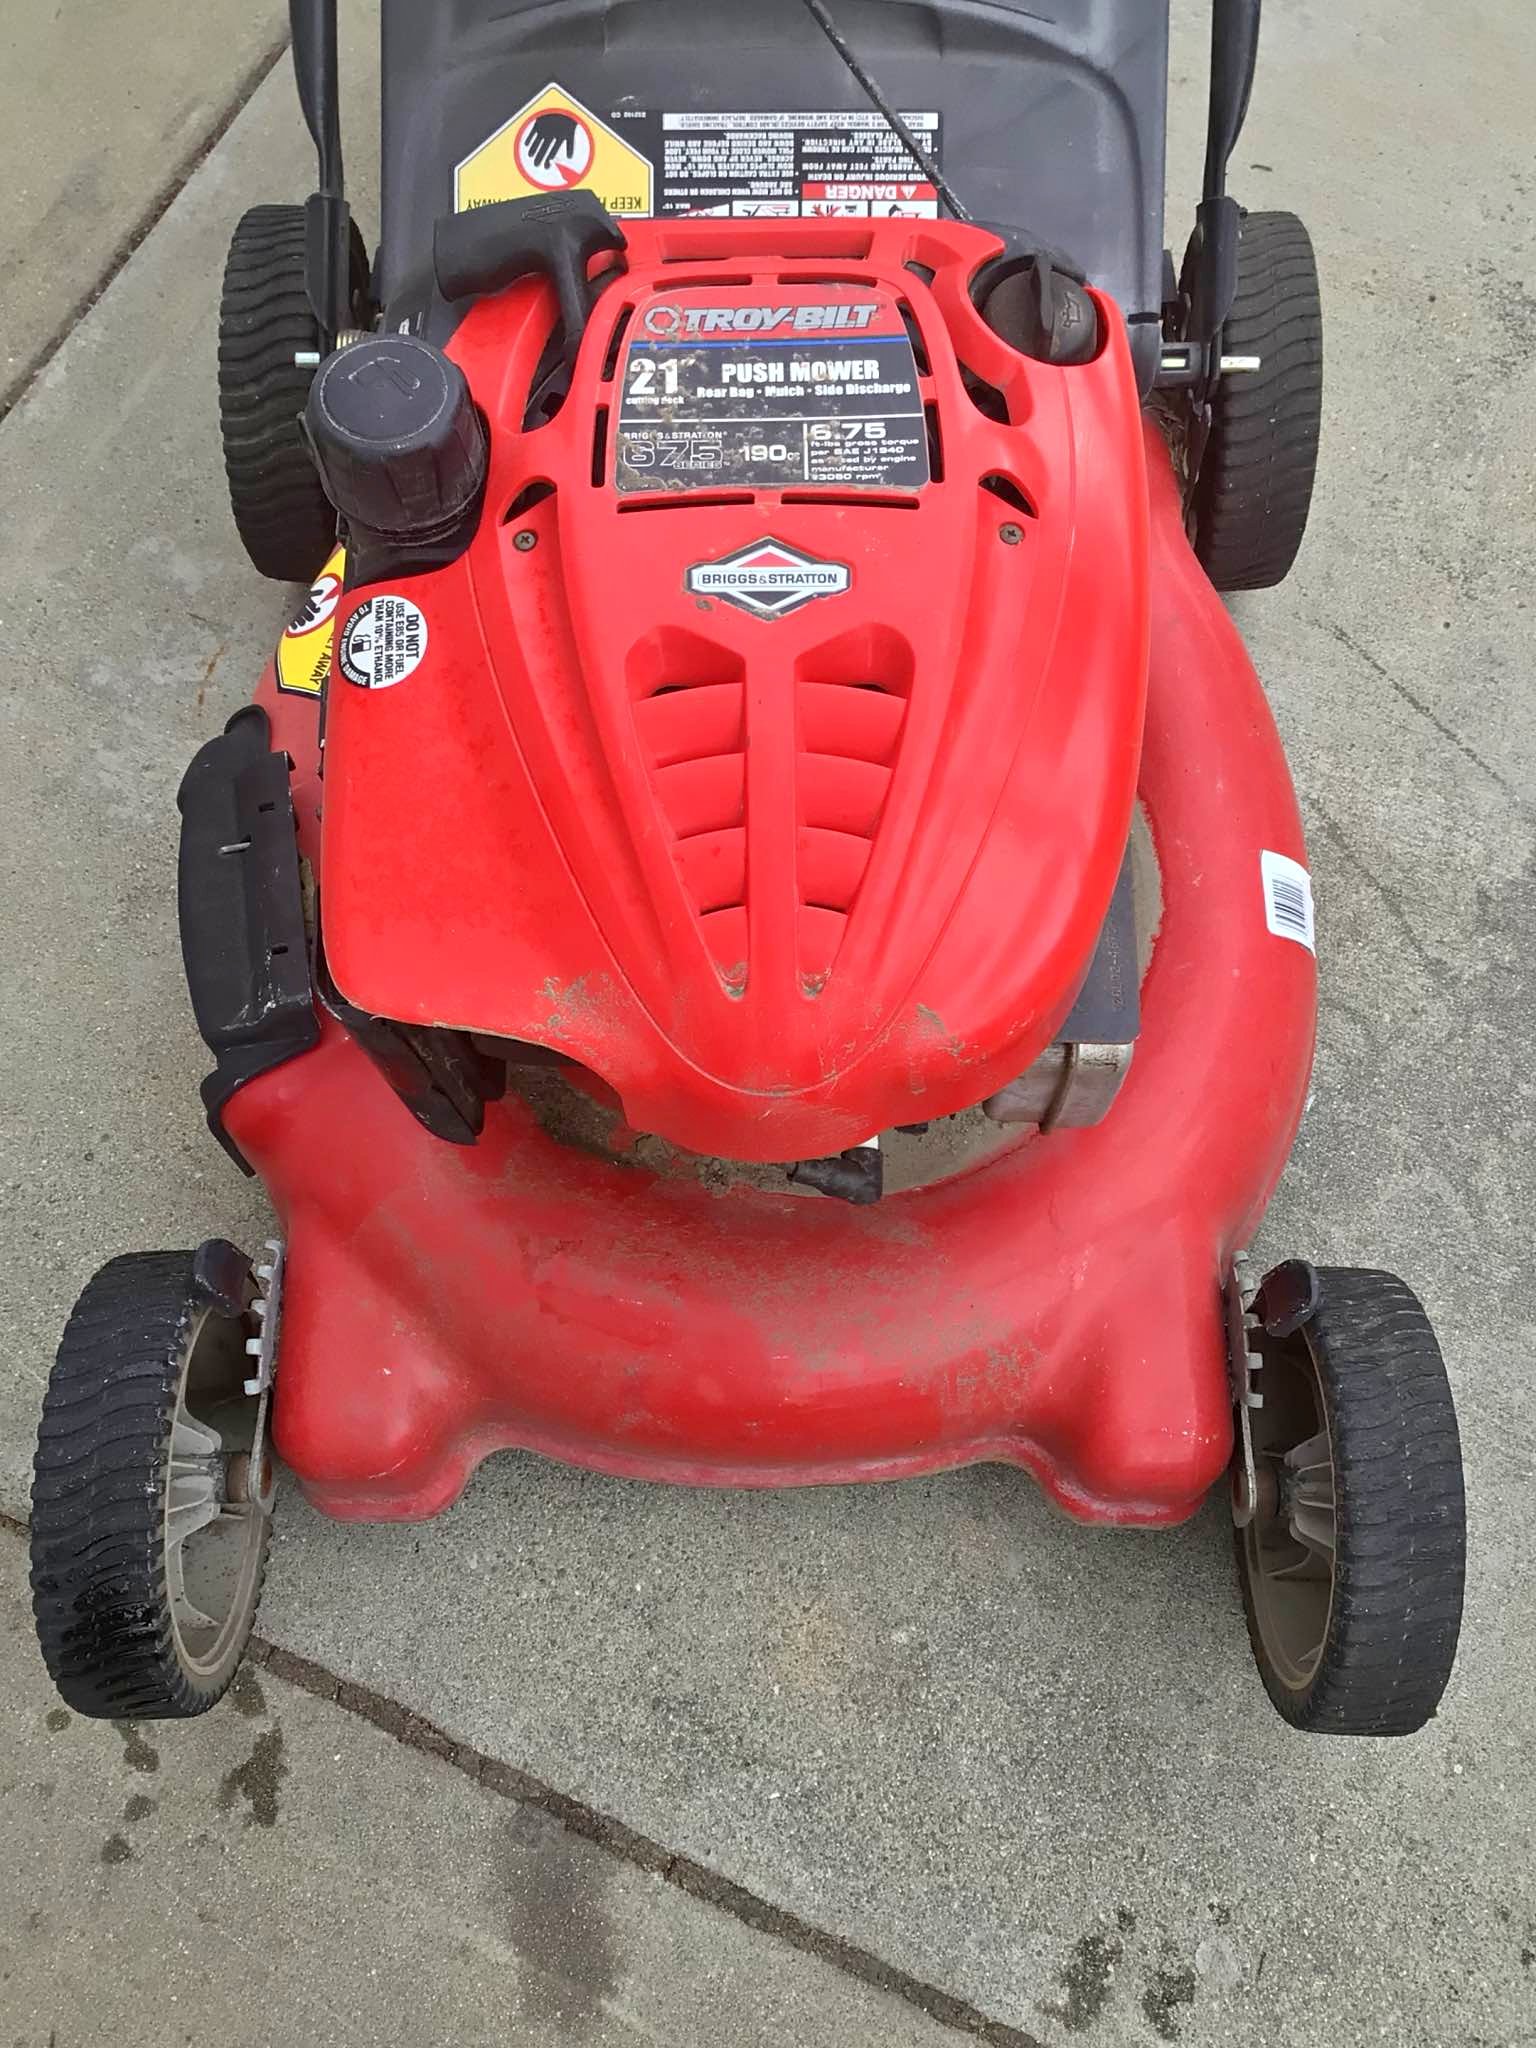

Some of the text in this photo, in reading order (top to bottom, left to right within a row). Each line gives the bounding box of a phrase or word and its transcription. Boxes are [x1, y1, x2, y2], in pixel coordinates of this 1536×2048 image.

[825, 185, 897, 199] DANGER
[610, 197, 642, 209] KEEP
[683, 303, 878, 333] TROY-BILT
[721, 359, 881, 383] PUSH MOWER
[696, 382, 912, 399] Rear Bag Mulch Side Discharge
[810, 448, 831, 457] per
[863, 446, 905, 455] J1940
[881, 438, 920, 447] torque
[811, 463, 890, 473] manufacturer
[880, 454, 917, 464] engine
[701, 572, 838, 585] BRIGGS&STRATTON
[359, 604, 369, 617] TO
[375, 599, 384, 622] THAN
[345, 615, 359, 637] AVOID
[385, 601, 394, 680] CONTAINING MORE
[395, 602, 404, 675] USE E85 OR FUEL
[406, 614, 419, 658] DO NOT
[310, 652, 331, 685] AWAY
[374, 645, 383, 685] ETHANOL
